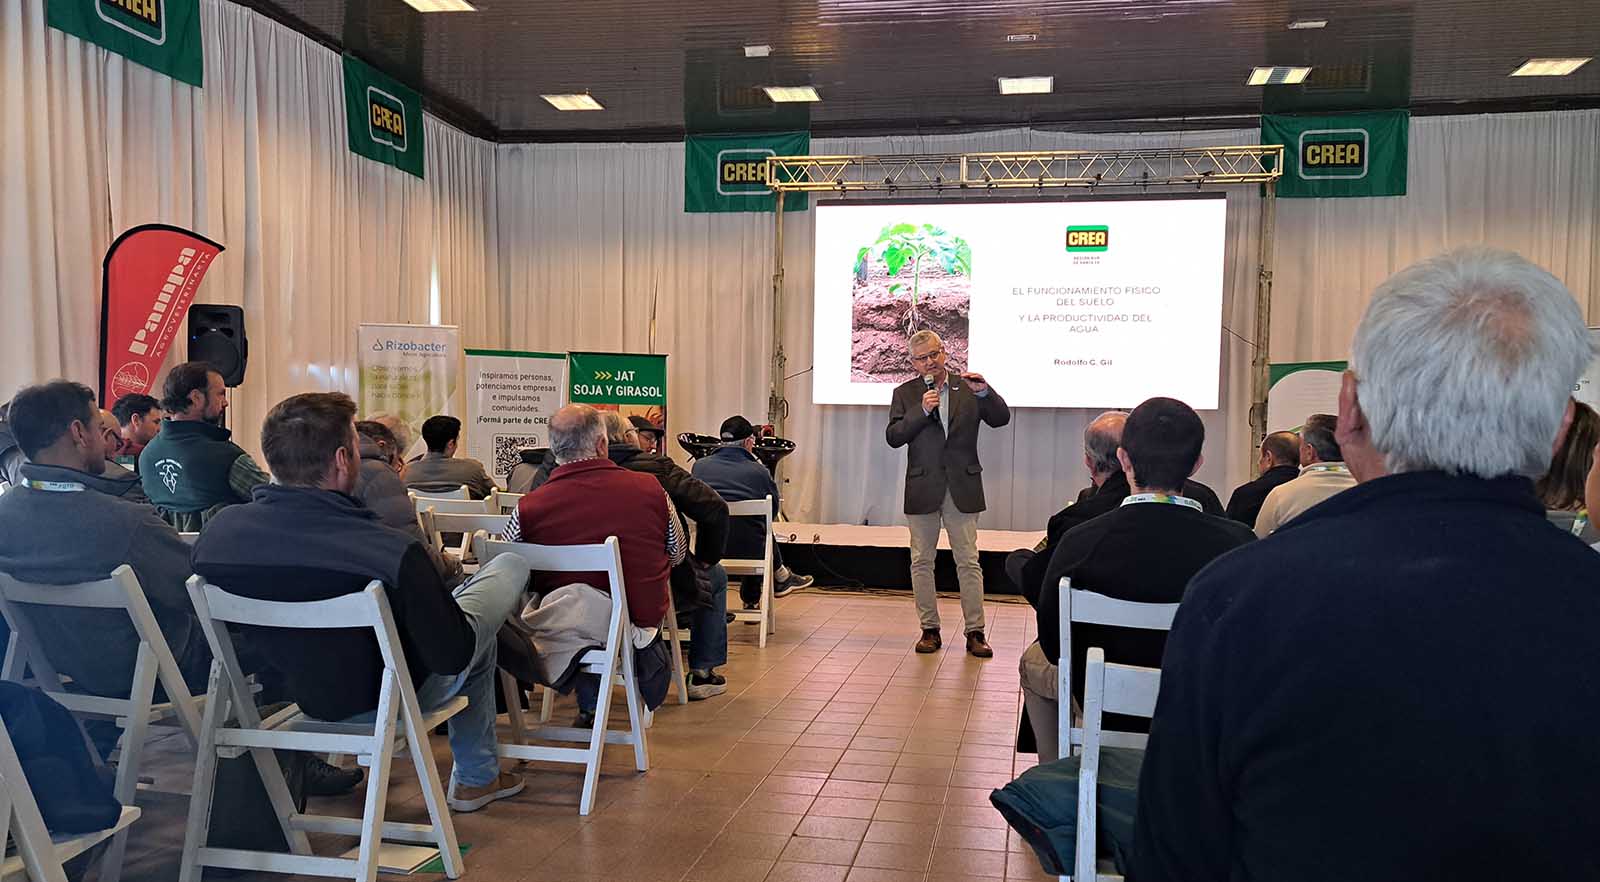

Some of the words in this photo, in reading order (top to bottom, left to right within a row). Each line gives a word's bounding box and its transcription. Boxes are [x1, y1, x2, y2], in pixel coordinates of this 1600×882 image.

[372, 103, 403, 135] CREA
[1306, 143, 1360, 165] CREA
[724, 162, 768, 182] CREA
[1069, 231, 1106, 246] CREA
[1012, 287, 1025, 296] EL
[1027, 287, 1122, 296] FUNCIONAMIENTO
[156, 252, 212, 358] AGROVETERINARIA
[1056, 298, 1076, 306] DEL
[1079, 298, 1115, 306] SUELO
[1018, 314, 1025, 323] Y
[1027, 314, 1041, 322] LA
[1042, 313, 1129, 323] PRODUCTIVIDAD
[1132, 314, 1153, 323] DEL
[1069, 324, 1100, 334] AGUA
[386, 340, 446, 352] Rizobacter
[1054, 358, 1088, 366] Rodolfo
[479, 371, 519, 380] Inspiramos
[519, 373, 553, 383] personas,
[614, 370, 636, 382] JAT
[475, 382, 522, 391] potenciamos
[522, 385, 557, 393] empresas
[573, 384, 604, 396] SOJA
[605, 385, 614, 396] Y
[615, 385, 663, 398] GIRASOL
[498, 394, 542, 402] impulsamos
[502, 417, 522, 425] parte
[522, 416, 533, 424] de
[533, 416, 551, 425] CRE
